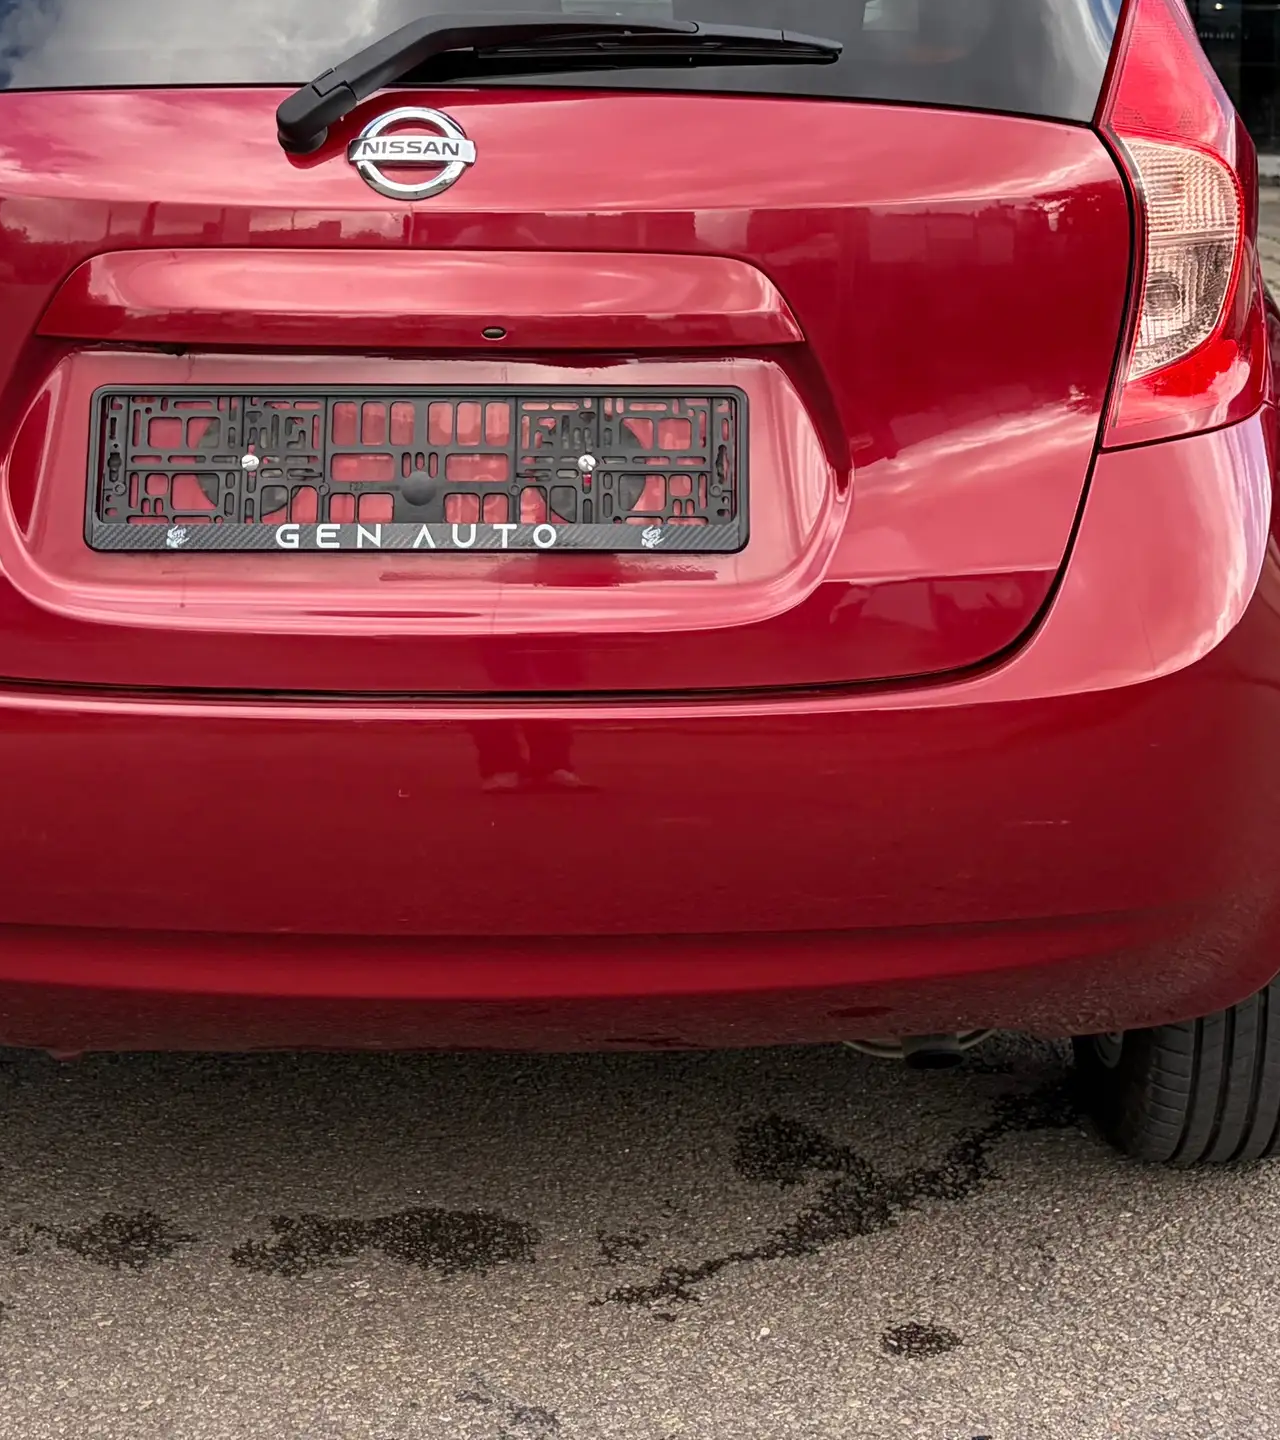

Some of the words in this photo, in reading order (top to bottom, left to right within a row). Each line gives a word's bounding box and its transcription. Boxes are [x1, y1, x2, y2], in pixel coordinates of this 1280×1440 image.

[362, 140, 460, 156] NISSAN
[275, 523, 382, 549] GEN
[412, 523, 558, 549] AUTO
